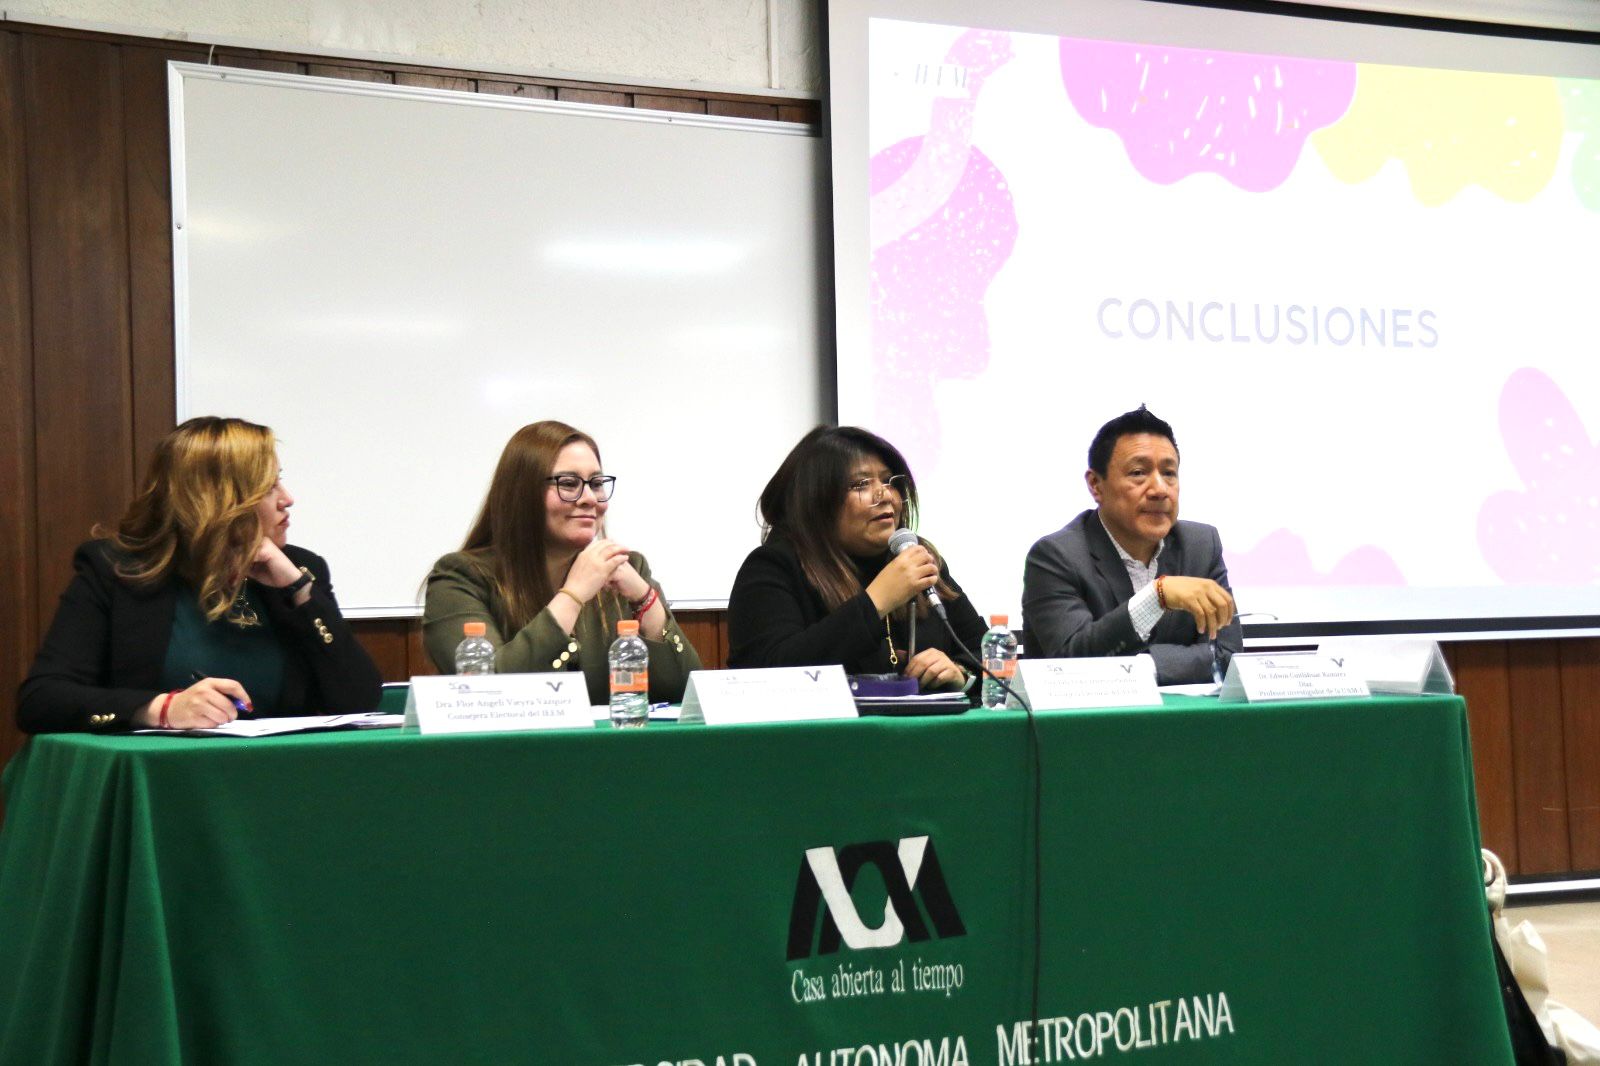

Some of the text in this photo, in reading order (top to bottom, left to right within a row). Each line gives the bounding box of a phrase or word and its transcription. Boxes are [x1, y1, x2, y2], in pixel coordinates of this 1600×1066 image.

[1096, 297, 1440, 349] CONCLUSIONES
[791, 956, 964, 1003] Casa abierta al tiempo
[996, 990, 1236, 1066] METROPOLITANA
